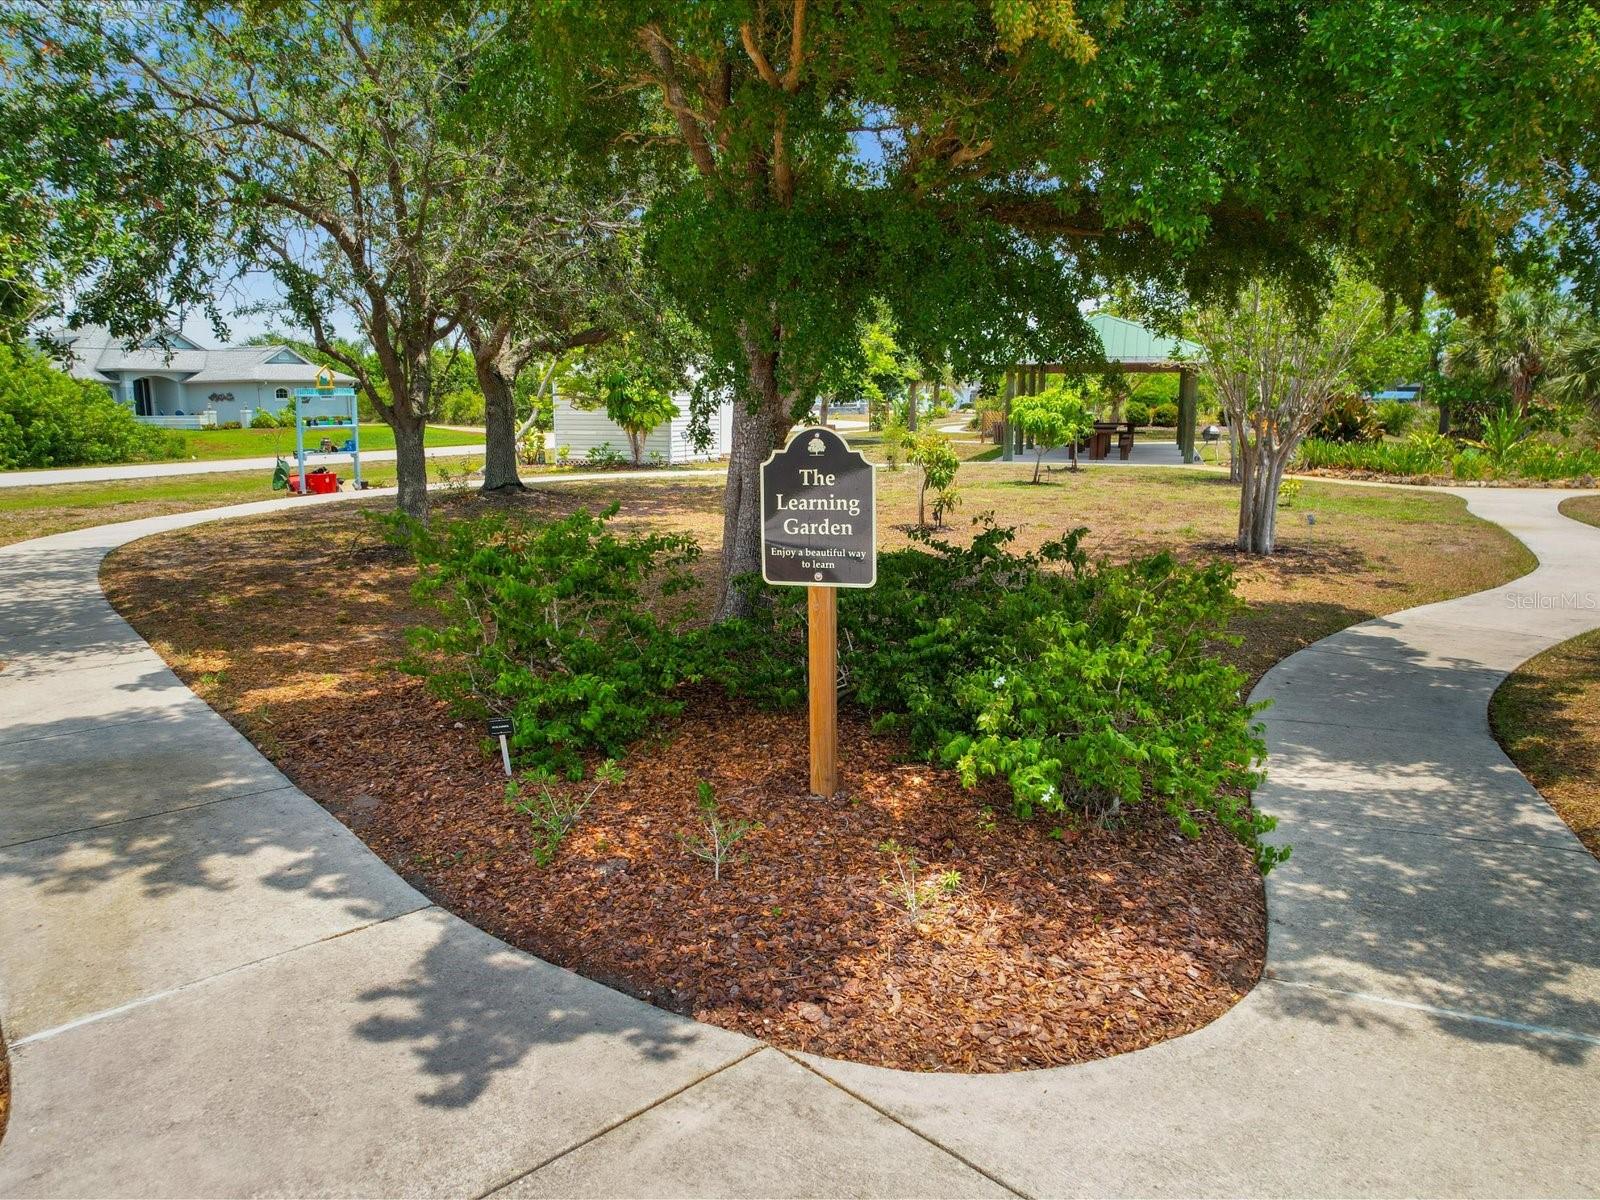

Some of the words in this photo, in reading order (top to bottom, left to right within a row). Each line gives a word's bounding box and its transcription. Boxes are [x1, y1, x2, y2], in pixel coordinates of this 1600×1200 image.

[799, 469, 835, 486] The
[776, 494, 860, 516] Learning
[784, 518, 853, 535] Garden
[771, 548, 796, 558] Enjoy
[805, 548, 846, 557] beautiful
[848, 551, 866, 559] way
[802, 561, 810, 569] to
[812, 560, 835, 569] learn
